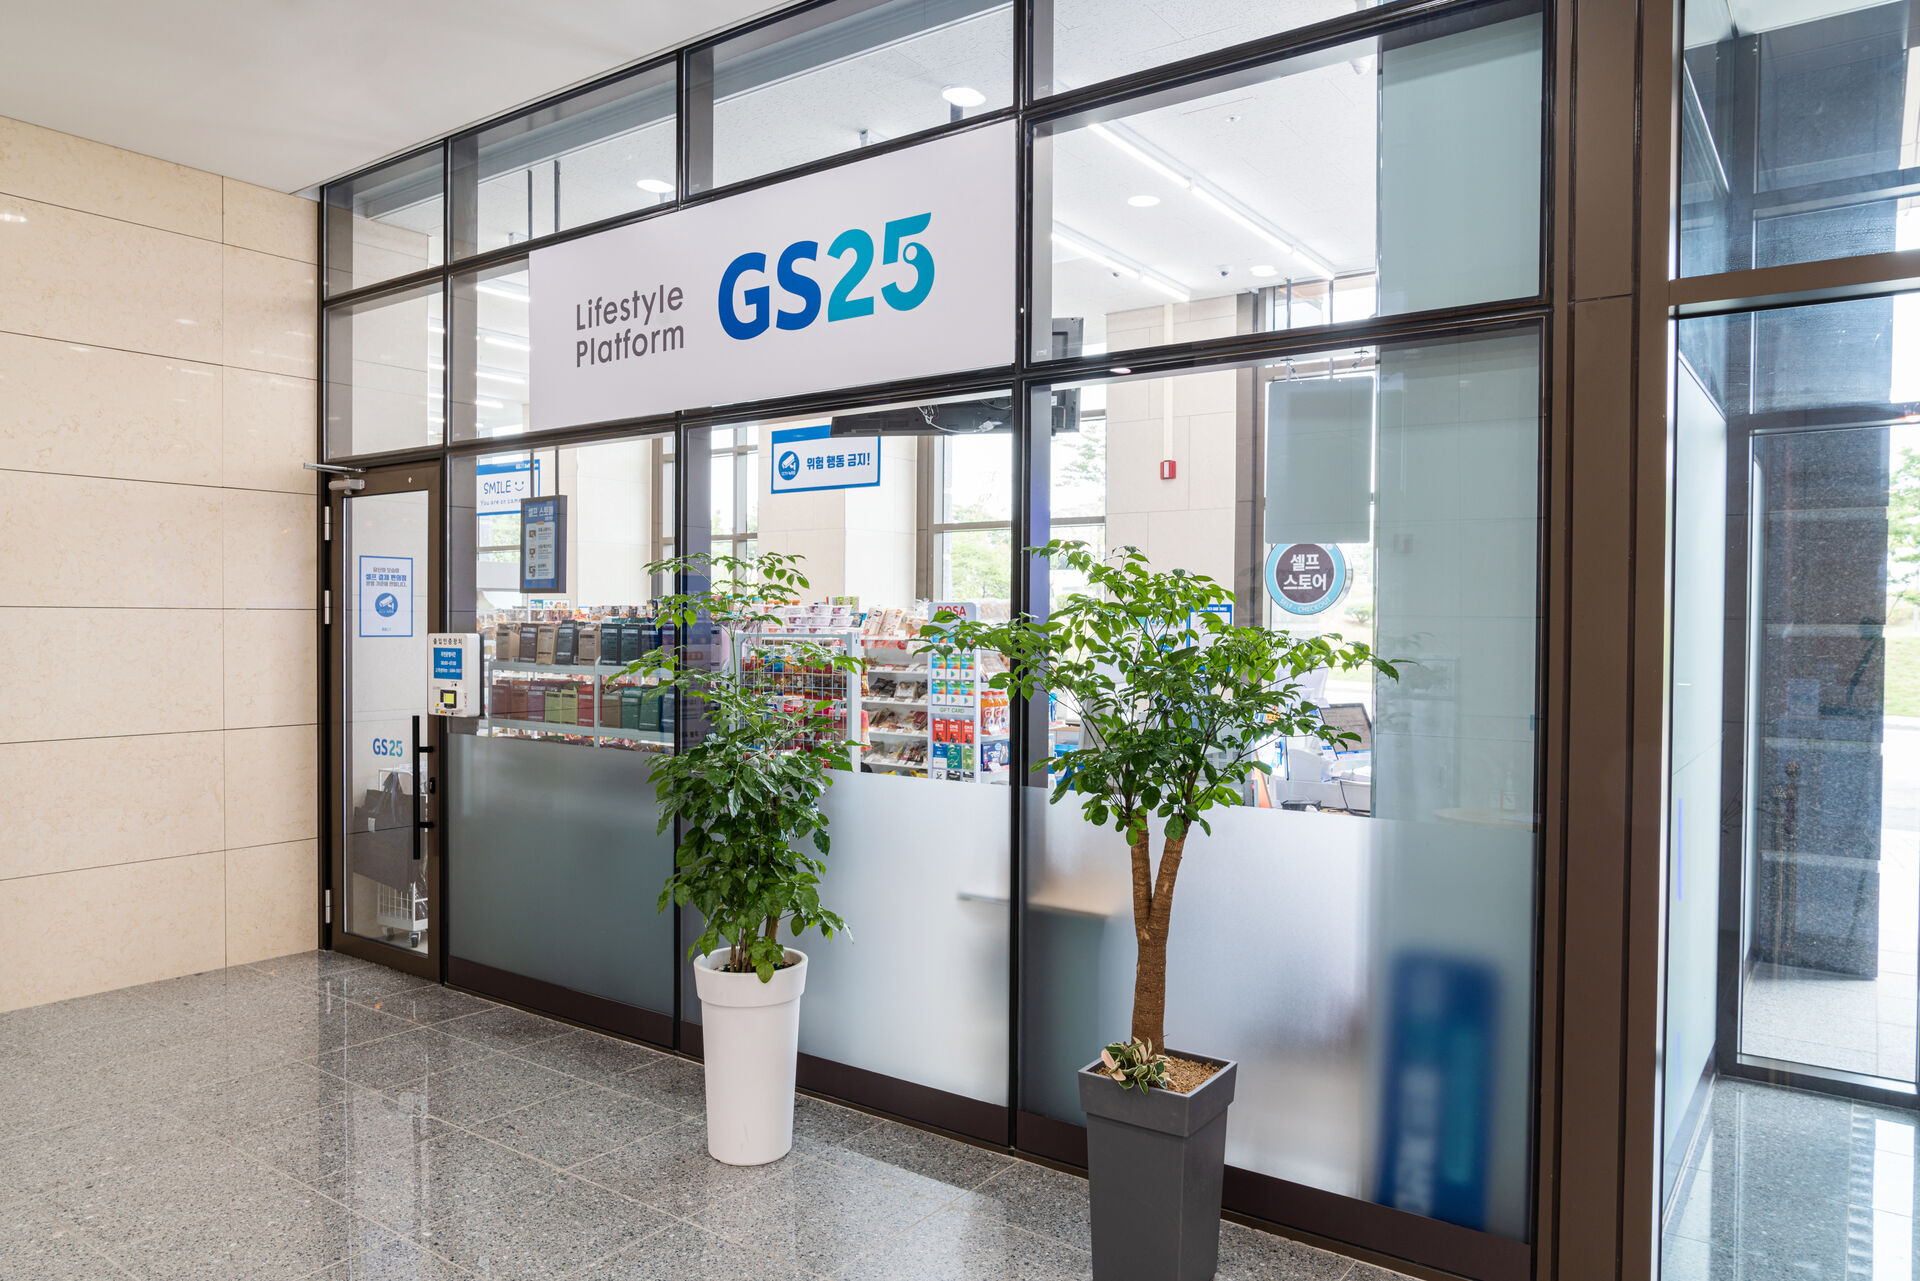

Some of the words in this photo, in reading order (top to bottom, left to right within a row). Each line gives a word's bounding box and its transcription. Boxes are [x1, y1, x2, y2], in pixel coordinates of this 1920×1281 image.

[718, 211, 936, 341] GS25
[576, 284, 684, 331] Lifestyle
[576, 324, 685, 368] Platform
[806, 456, 824, 470] 위험
[826, 454, 845, 469] 행동
[847, 452, 871, 467] 금지!
[483, 480, 511, 495] SMILE
[1290, 554, 1320, 572] 셀프
[1283, 573, 1327, 591] 스토어
[372, 737, 404, 758] GS25
